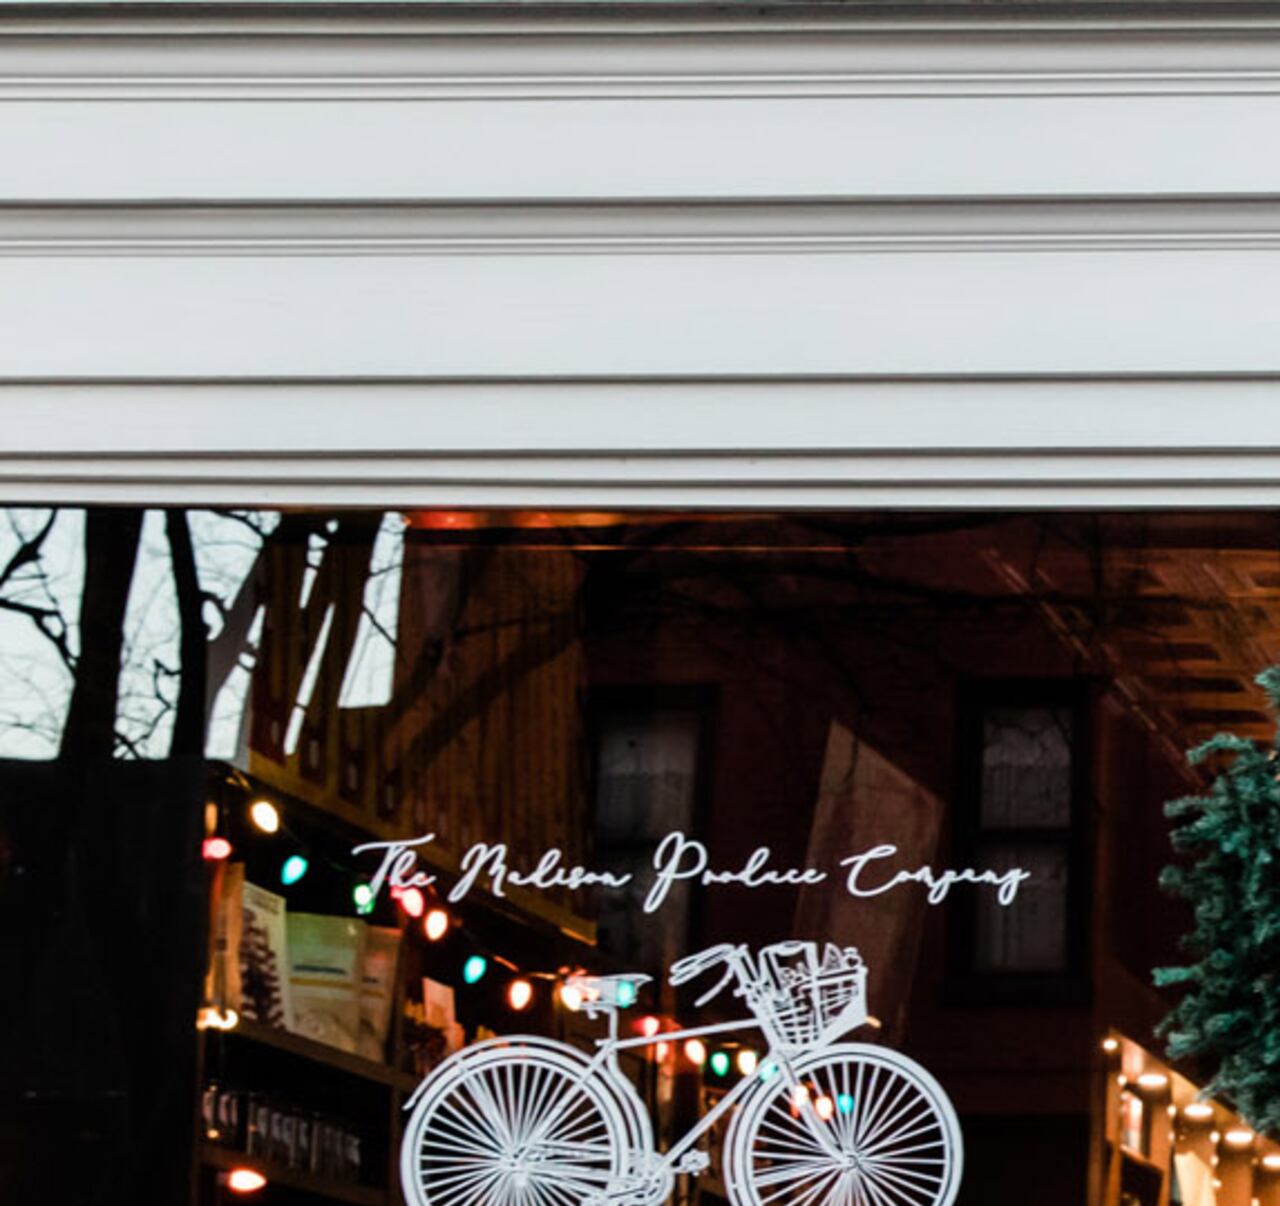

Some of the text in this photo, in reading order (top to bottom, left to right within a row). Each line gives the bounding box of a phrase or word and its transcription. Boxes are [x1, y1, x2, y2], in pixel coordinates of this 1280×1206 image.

[351, 831, 1031, 913] The Madison Produce Company
